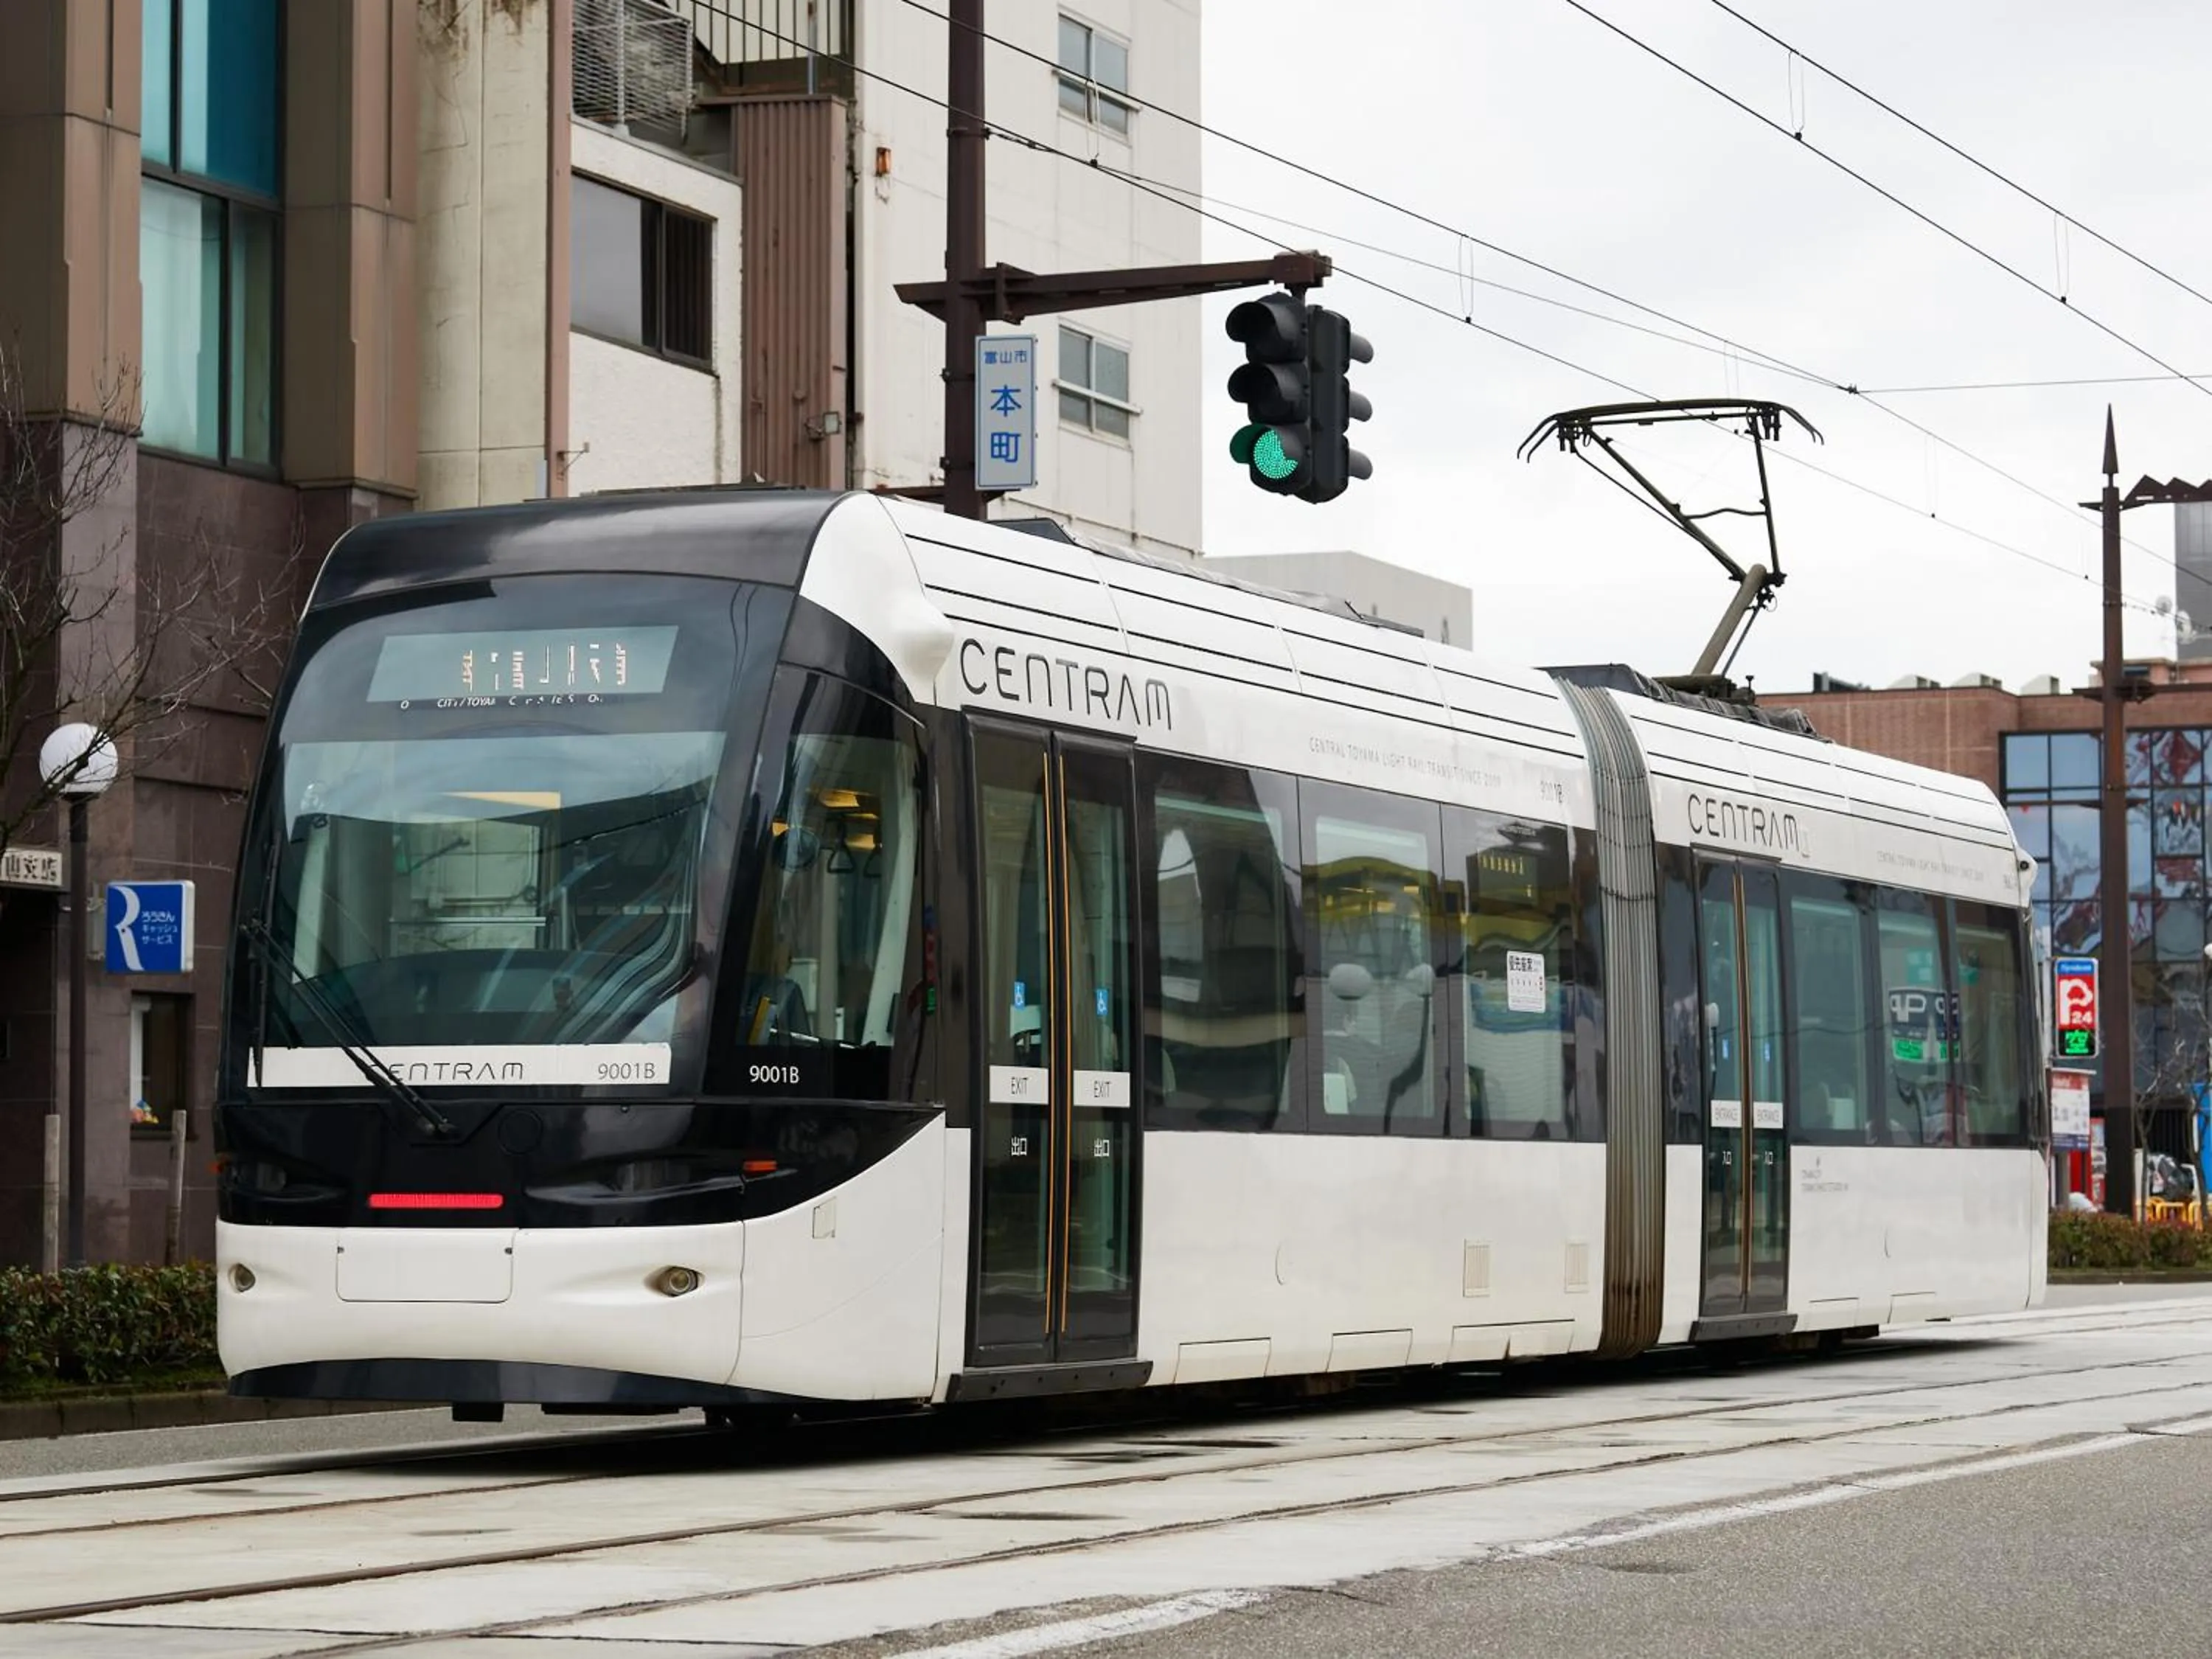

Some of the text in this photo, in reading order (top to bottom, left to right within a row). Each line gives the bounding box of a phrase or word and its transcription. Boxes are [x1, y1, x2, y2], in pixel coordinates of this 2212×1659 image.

[984, 350, 1027, 364] 富山市
[990, 384, 1022, 462] 本町
[961, 638, 1172, 731] CENTRAM
[1688, 793, 1800, 852] CENTRAM
[369, 1062, 656, 1081] ENTRAM 9001B
[749, 1064, 800, 1085] 9001B
[1011, 1076, 1029, 1096] EXIT
[1093, 1079, 1111, 1099] EXIT
[1011, 1135, 1028, 1156] 出口
[1093, 1138, 1110, 1158] 出口
